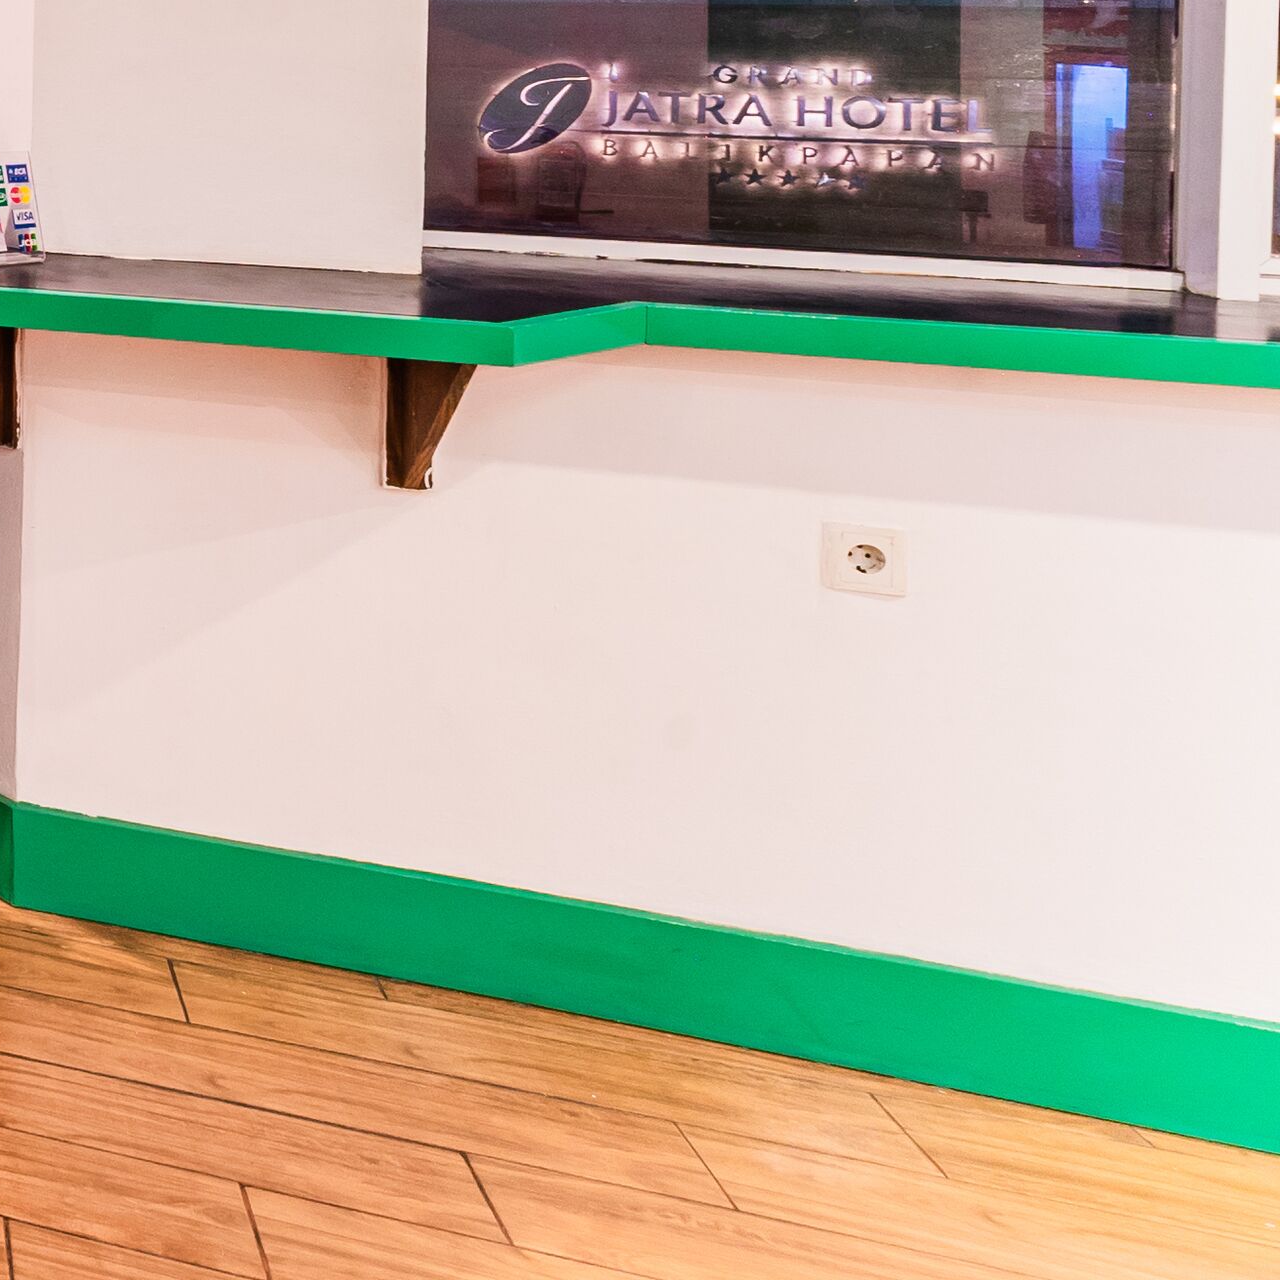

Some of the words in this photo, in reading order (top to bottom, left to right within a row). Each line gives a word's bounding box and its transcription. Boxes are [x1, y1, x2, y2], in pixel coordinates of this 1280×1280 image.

[711, 64, 874, 87] GRAND
[601, 90, 773, 127] JATRA
[795, 95, 993, 134] HOTEL
[16, 212, 34, 221] VISA
